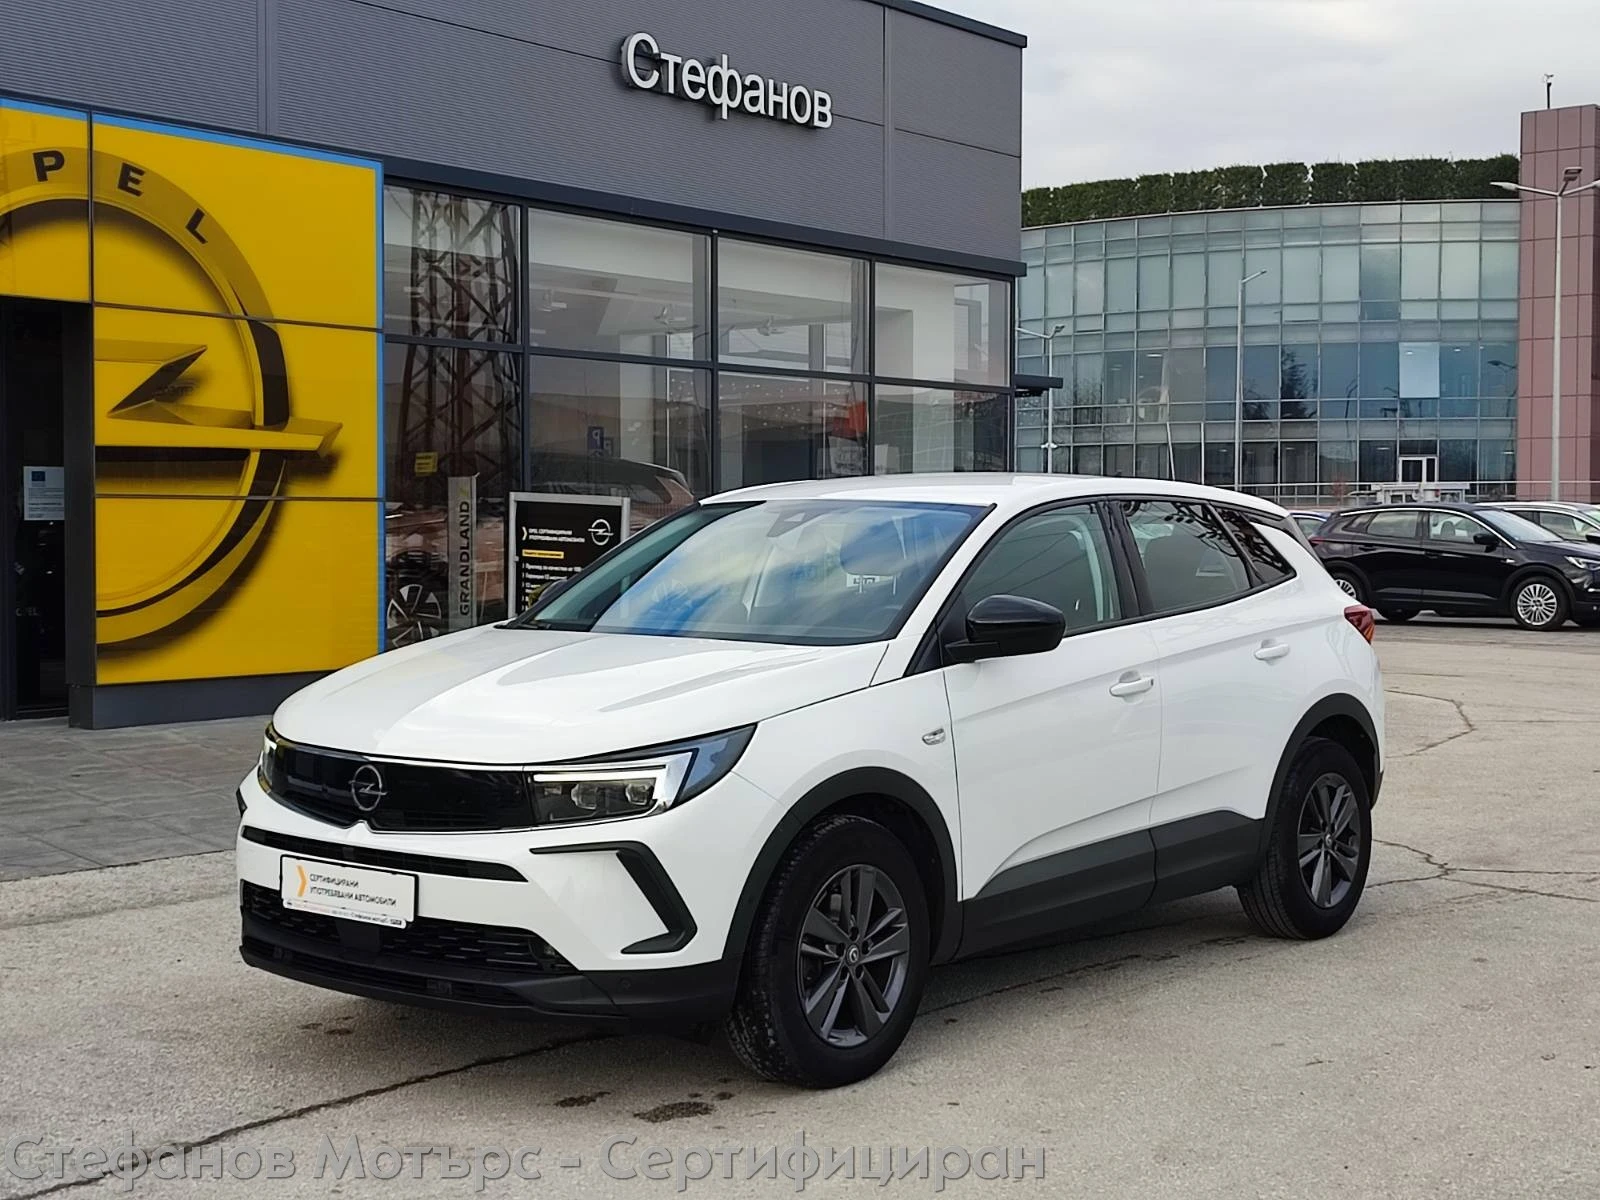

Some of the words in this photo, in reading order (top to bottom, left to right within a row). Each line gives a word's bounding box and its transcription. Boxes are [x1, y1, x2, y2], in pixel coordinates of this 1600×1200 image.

[622, 32, 832, 128] Стефанов
[33, 150, 208, 244] PEL
[460, 501, 470, 616] GRANDLAND
